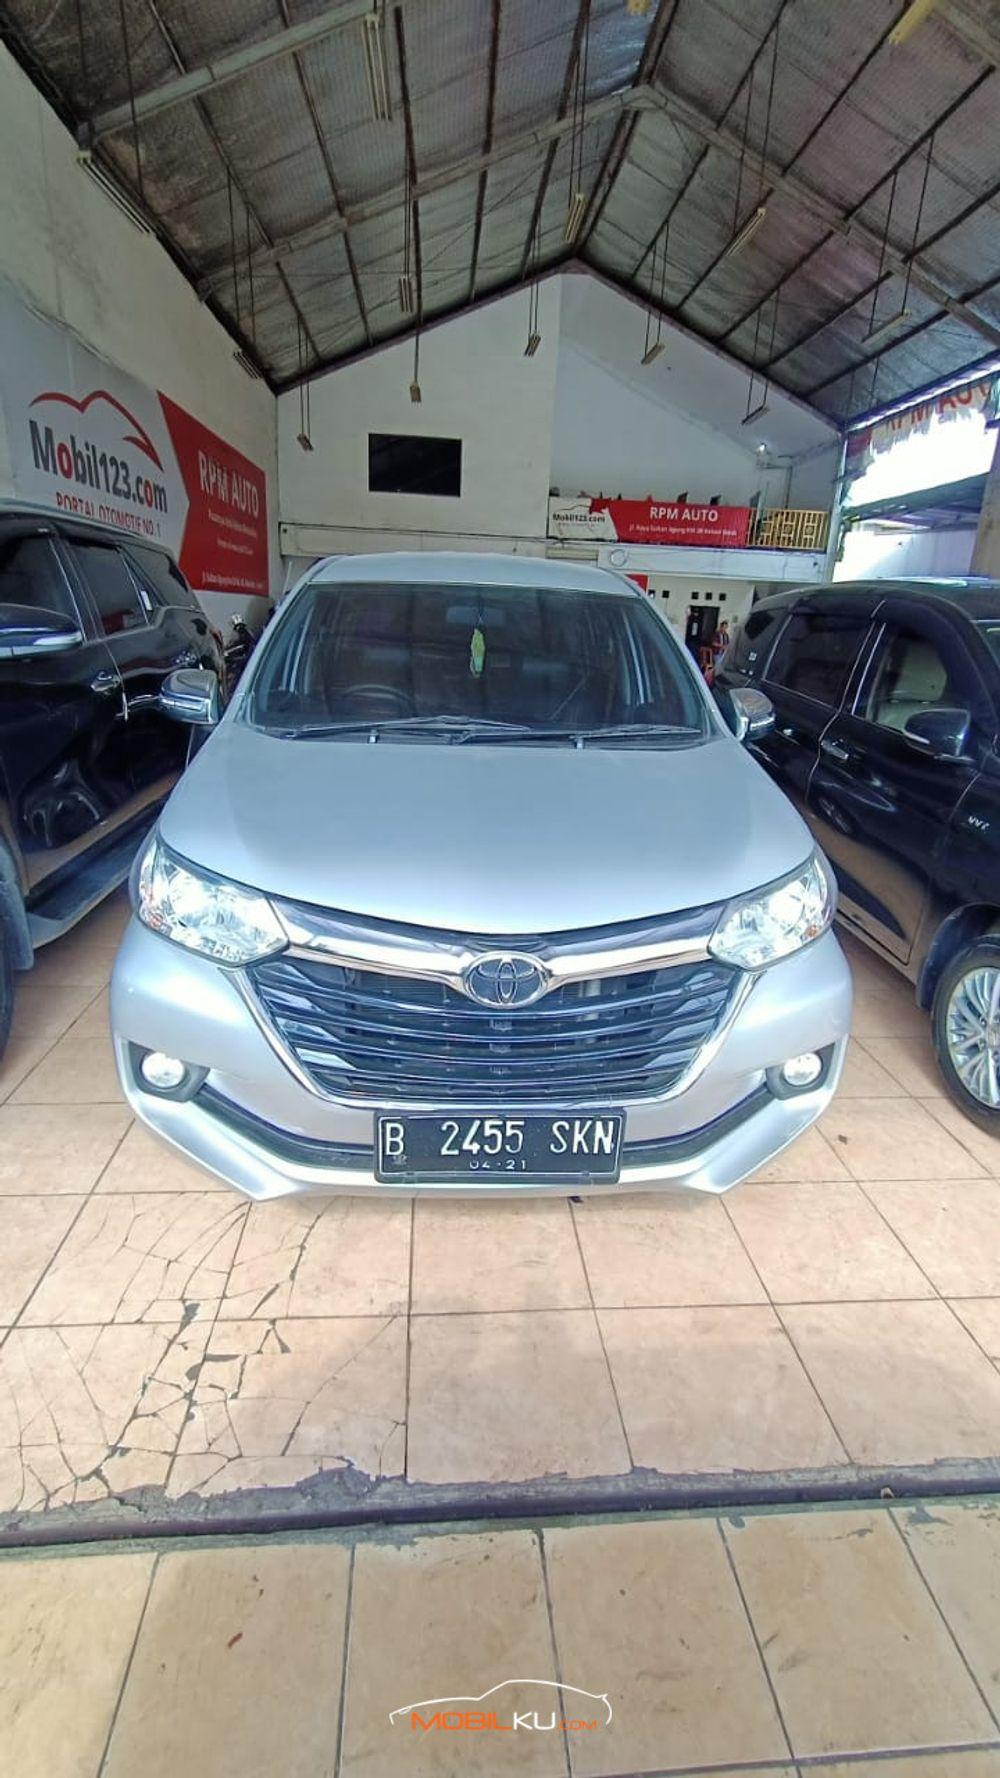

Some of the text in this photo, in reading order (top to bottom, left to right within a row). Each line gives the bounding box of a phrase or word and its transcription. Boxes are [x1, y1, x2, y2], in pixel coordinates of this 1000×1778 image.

[29, 419, 168, 514] Mobil123.com
[199, 450, 259, 518] RPM AUTO
[553, 513, 605, 523] Mobil123.com
[650, 506, 718, 522] RPM AUTO
[385, 1120, 614, 1156] B 2455 SKN
